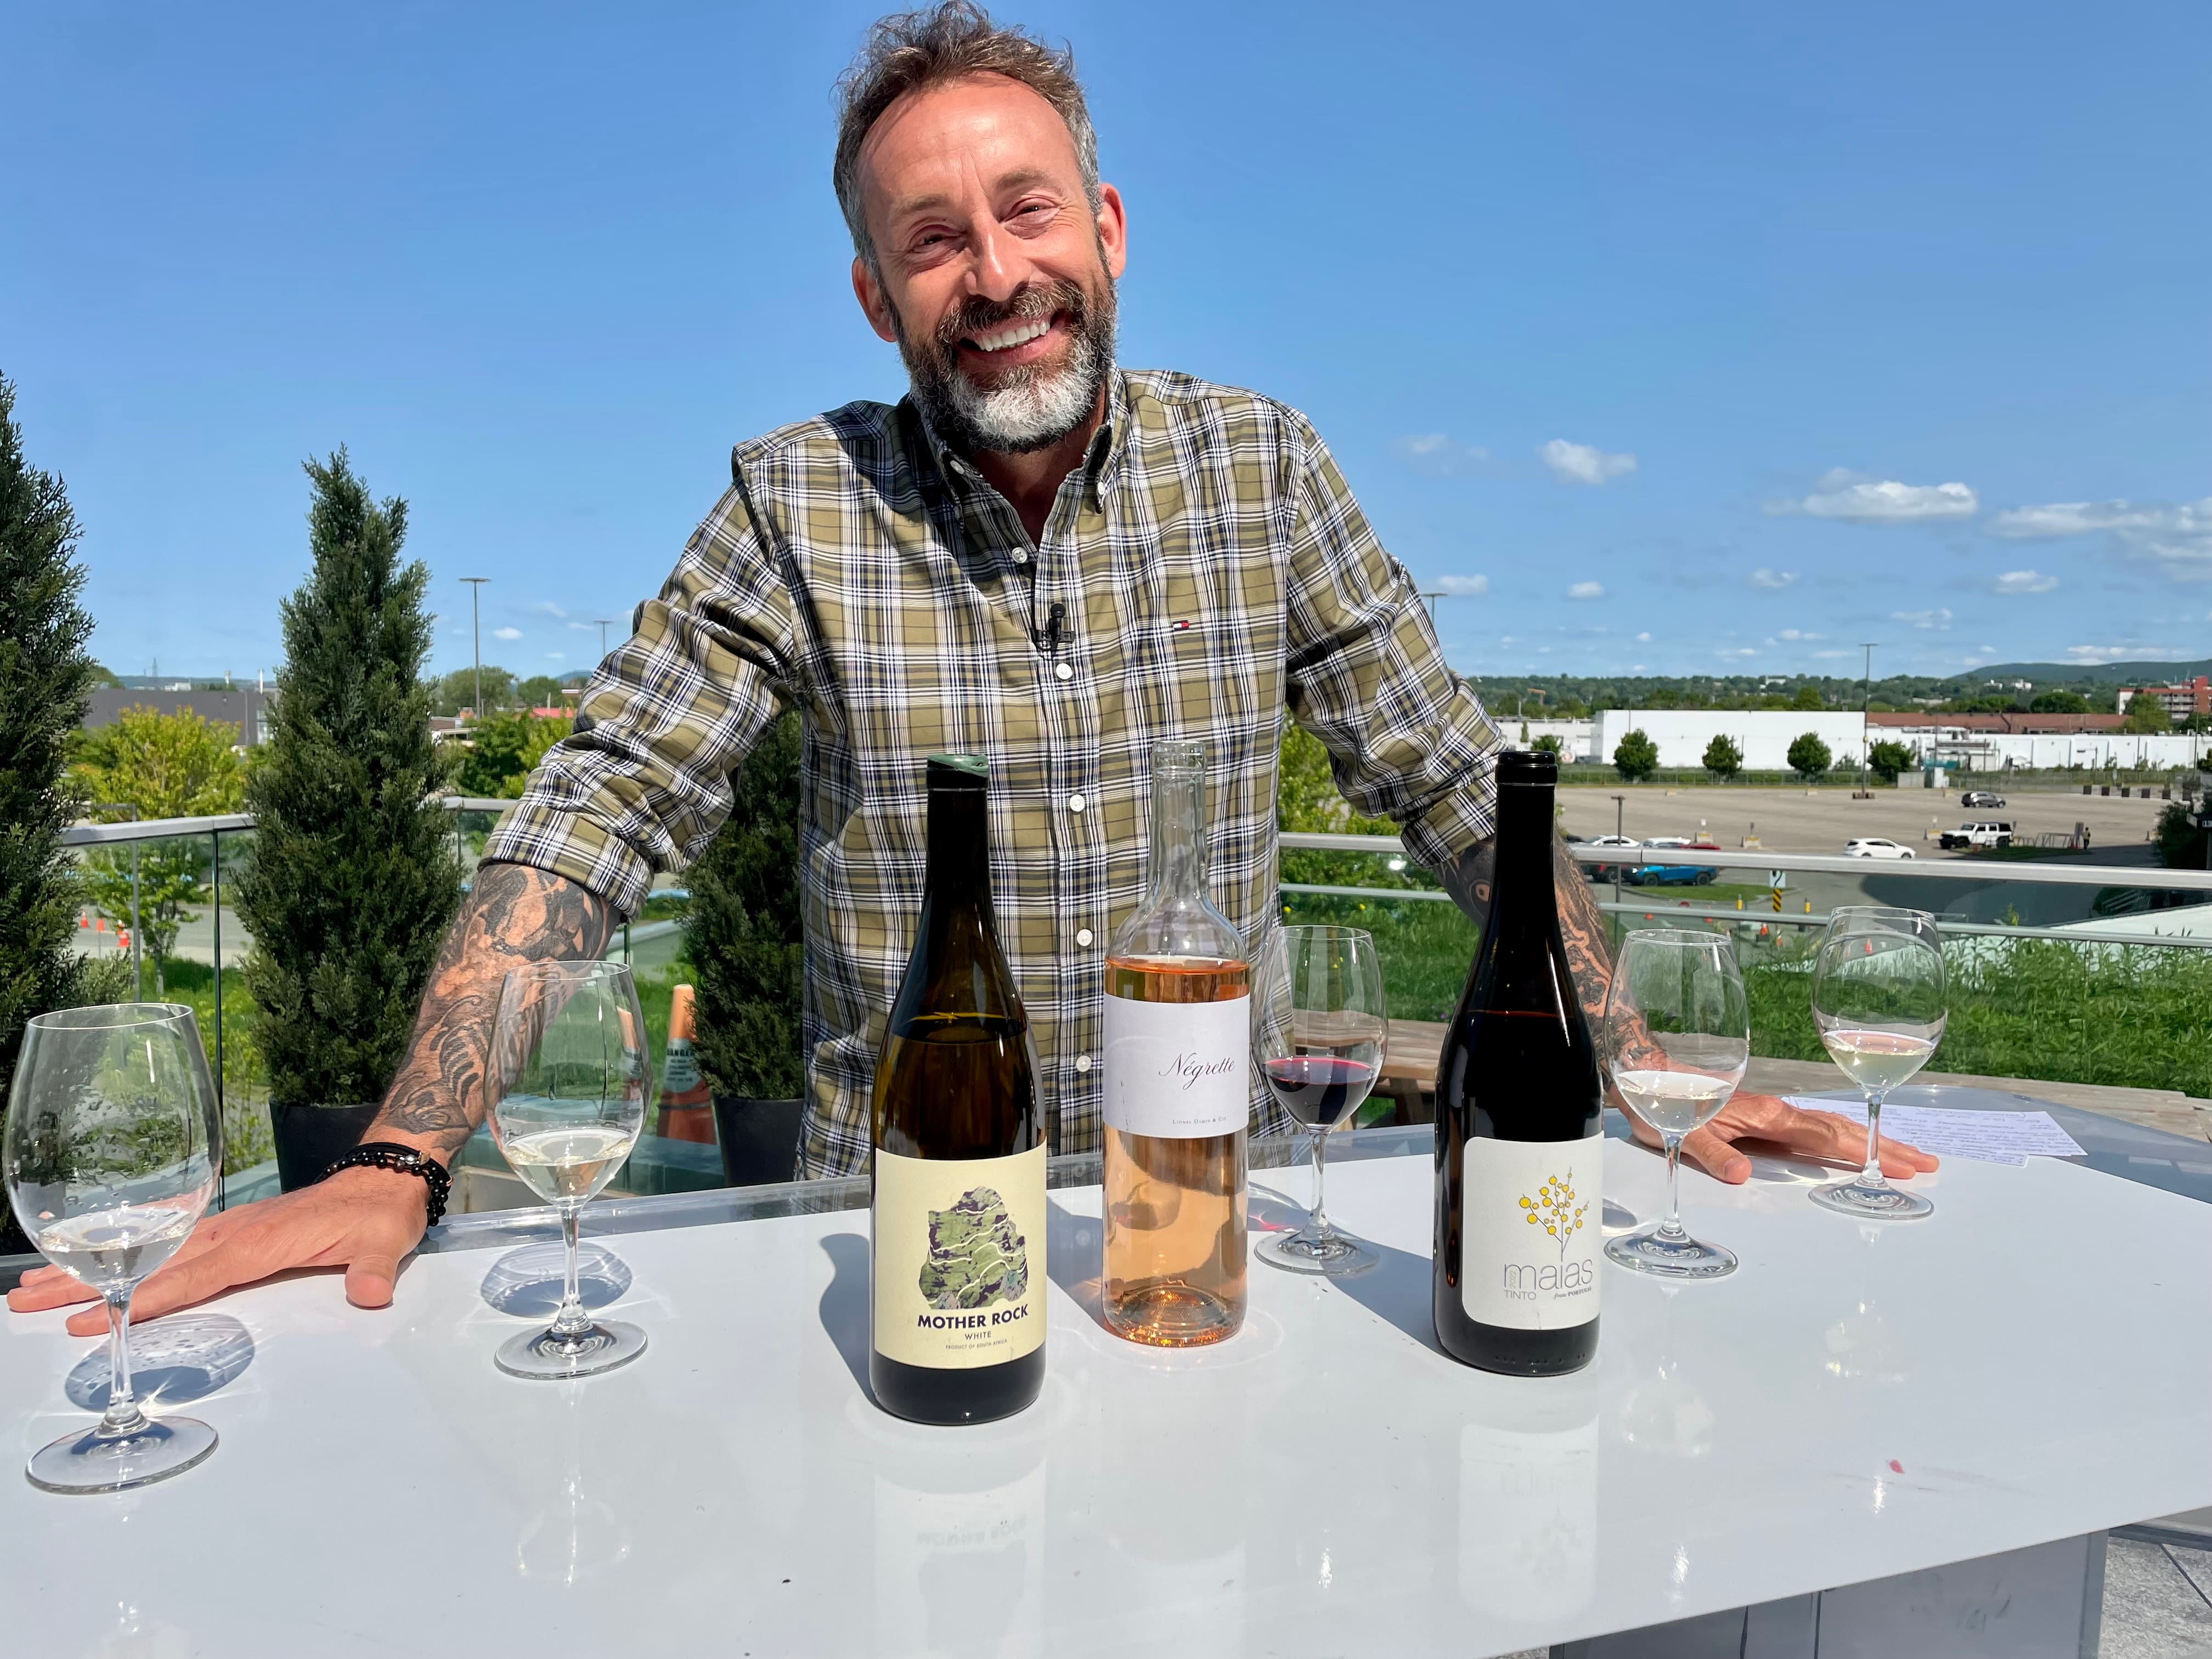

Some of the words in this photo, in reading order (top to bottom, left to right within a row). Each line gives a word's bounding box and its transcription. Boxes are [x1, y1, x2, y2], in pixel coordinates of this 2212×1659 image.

[1159, 1052, 1235, 1090] Négrette
[1504, 1289, 1537, 1301] TINTO
[917, 1314, 986, 1329] MOTHER
[992, 1304, 1029, 1325] ROCK
[964, 1330, 991, 1340] WHITE
